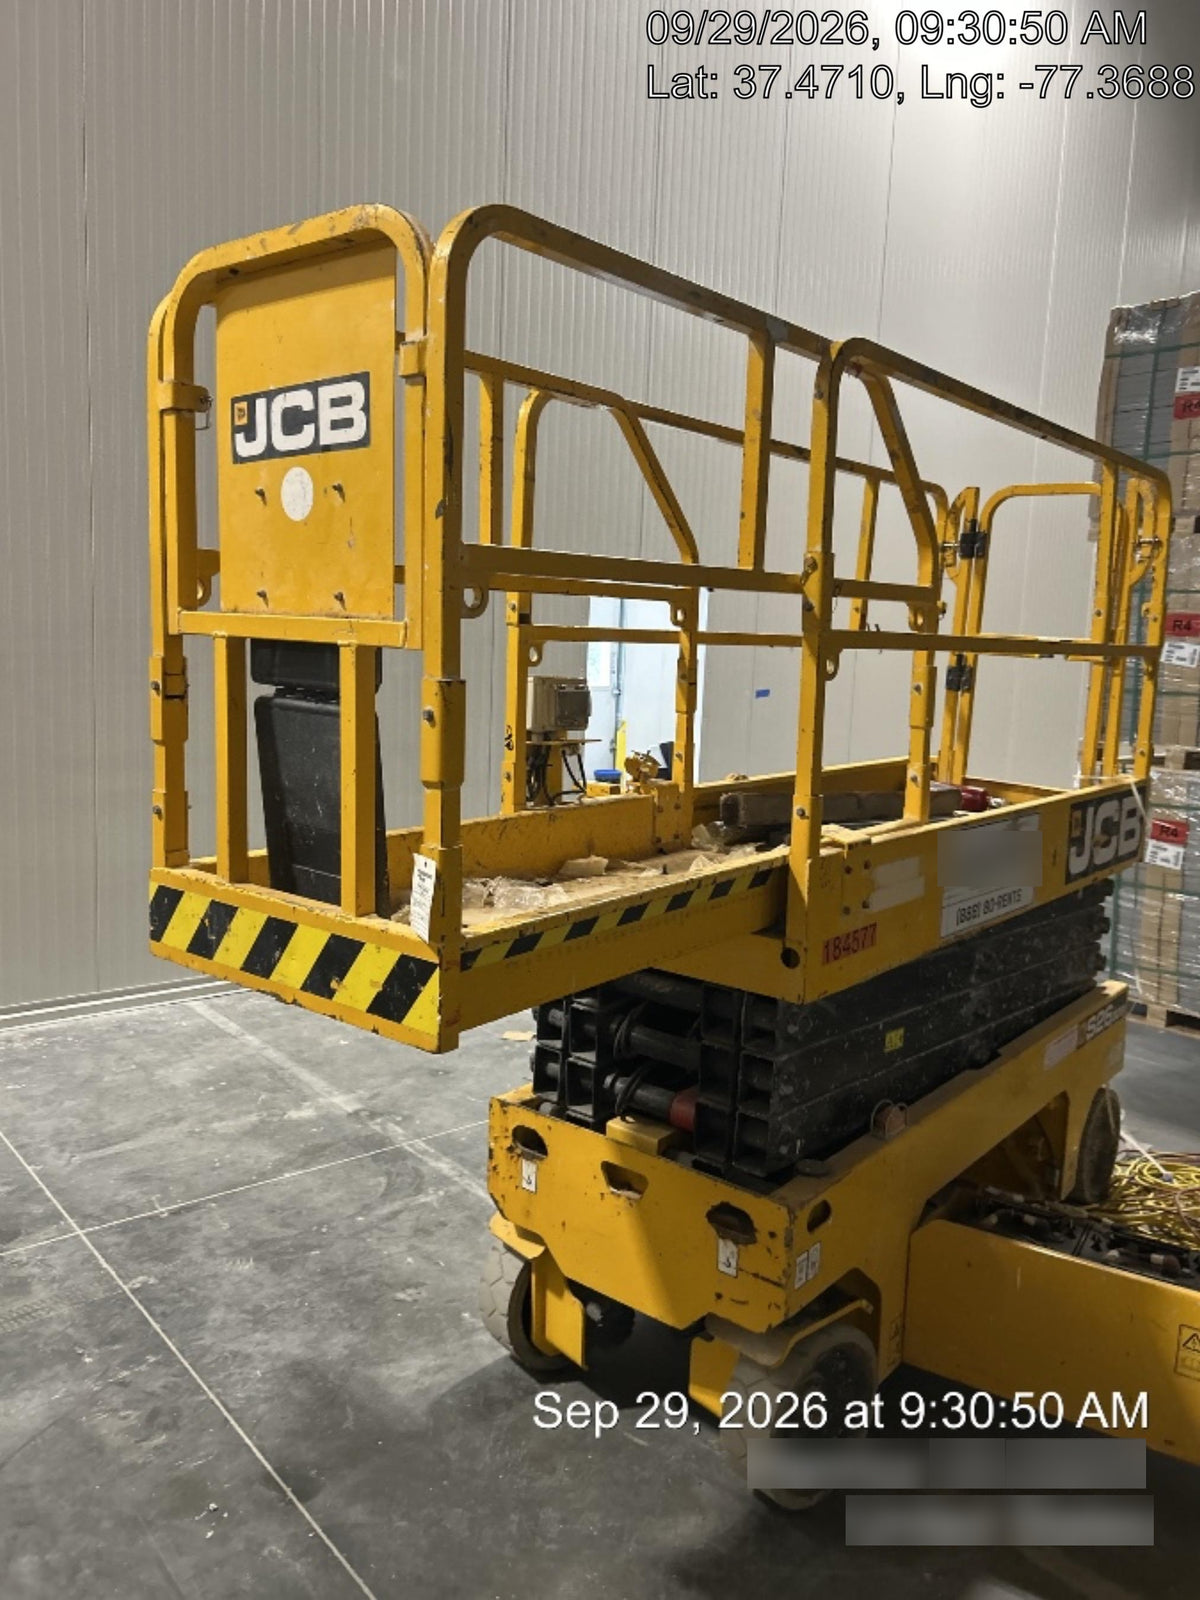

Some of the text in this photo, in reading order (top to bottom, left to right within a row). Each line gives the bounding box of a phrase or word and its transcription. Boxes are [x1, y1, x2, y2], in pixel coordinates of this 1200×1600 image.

[234, 380, 367, 458] JCB
[1172, 619, 1192, 632] R4
[1068, 795, 1143, 876] JCB
[1159, 825, 1178, 838] R4
[823, 921, 878, 965] 184577
